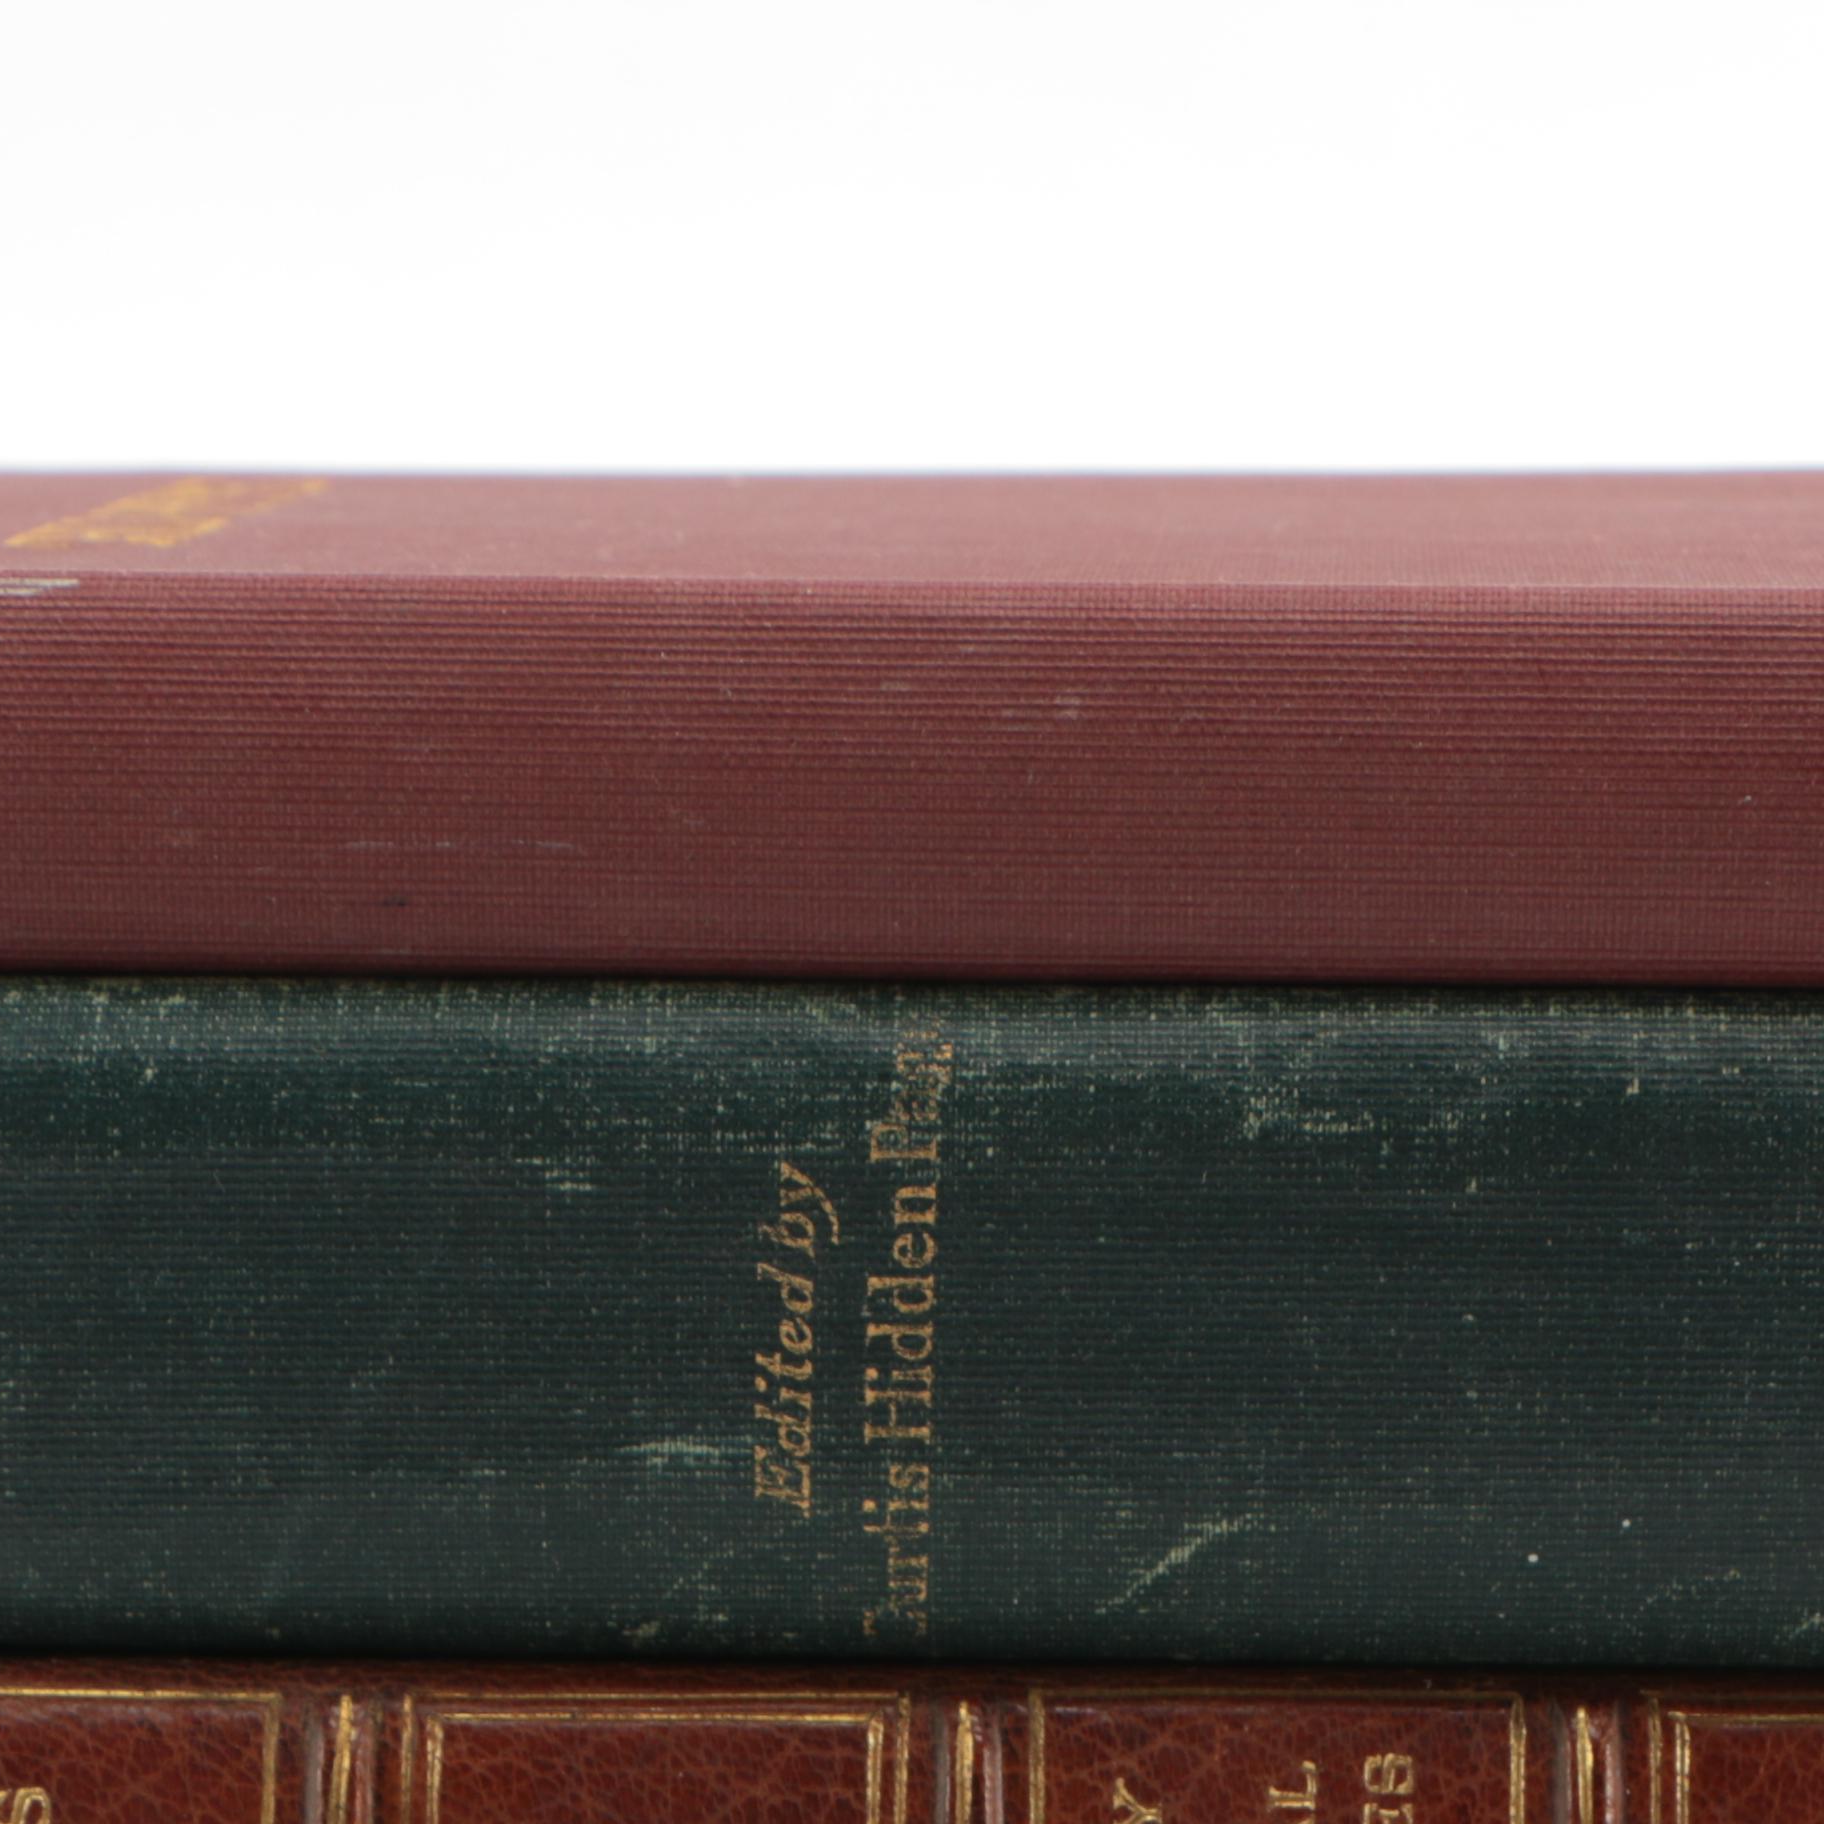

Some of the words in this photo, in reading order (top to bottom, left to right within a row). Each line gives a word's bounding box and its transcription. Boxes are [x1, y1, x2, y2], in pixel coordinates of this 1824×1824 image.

[759, 1161, 840, 1259] by
[865, 1183, 939, 1445] Hidden
[755, 1262, 814, 1518] Edited
